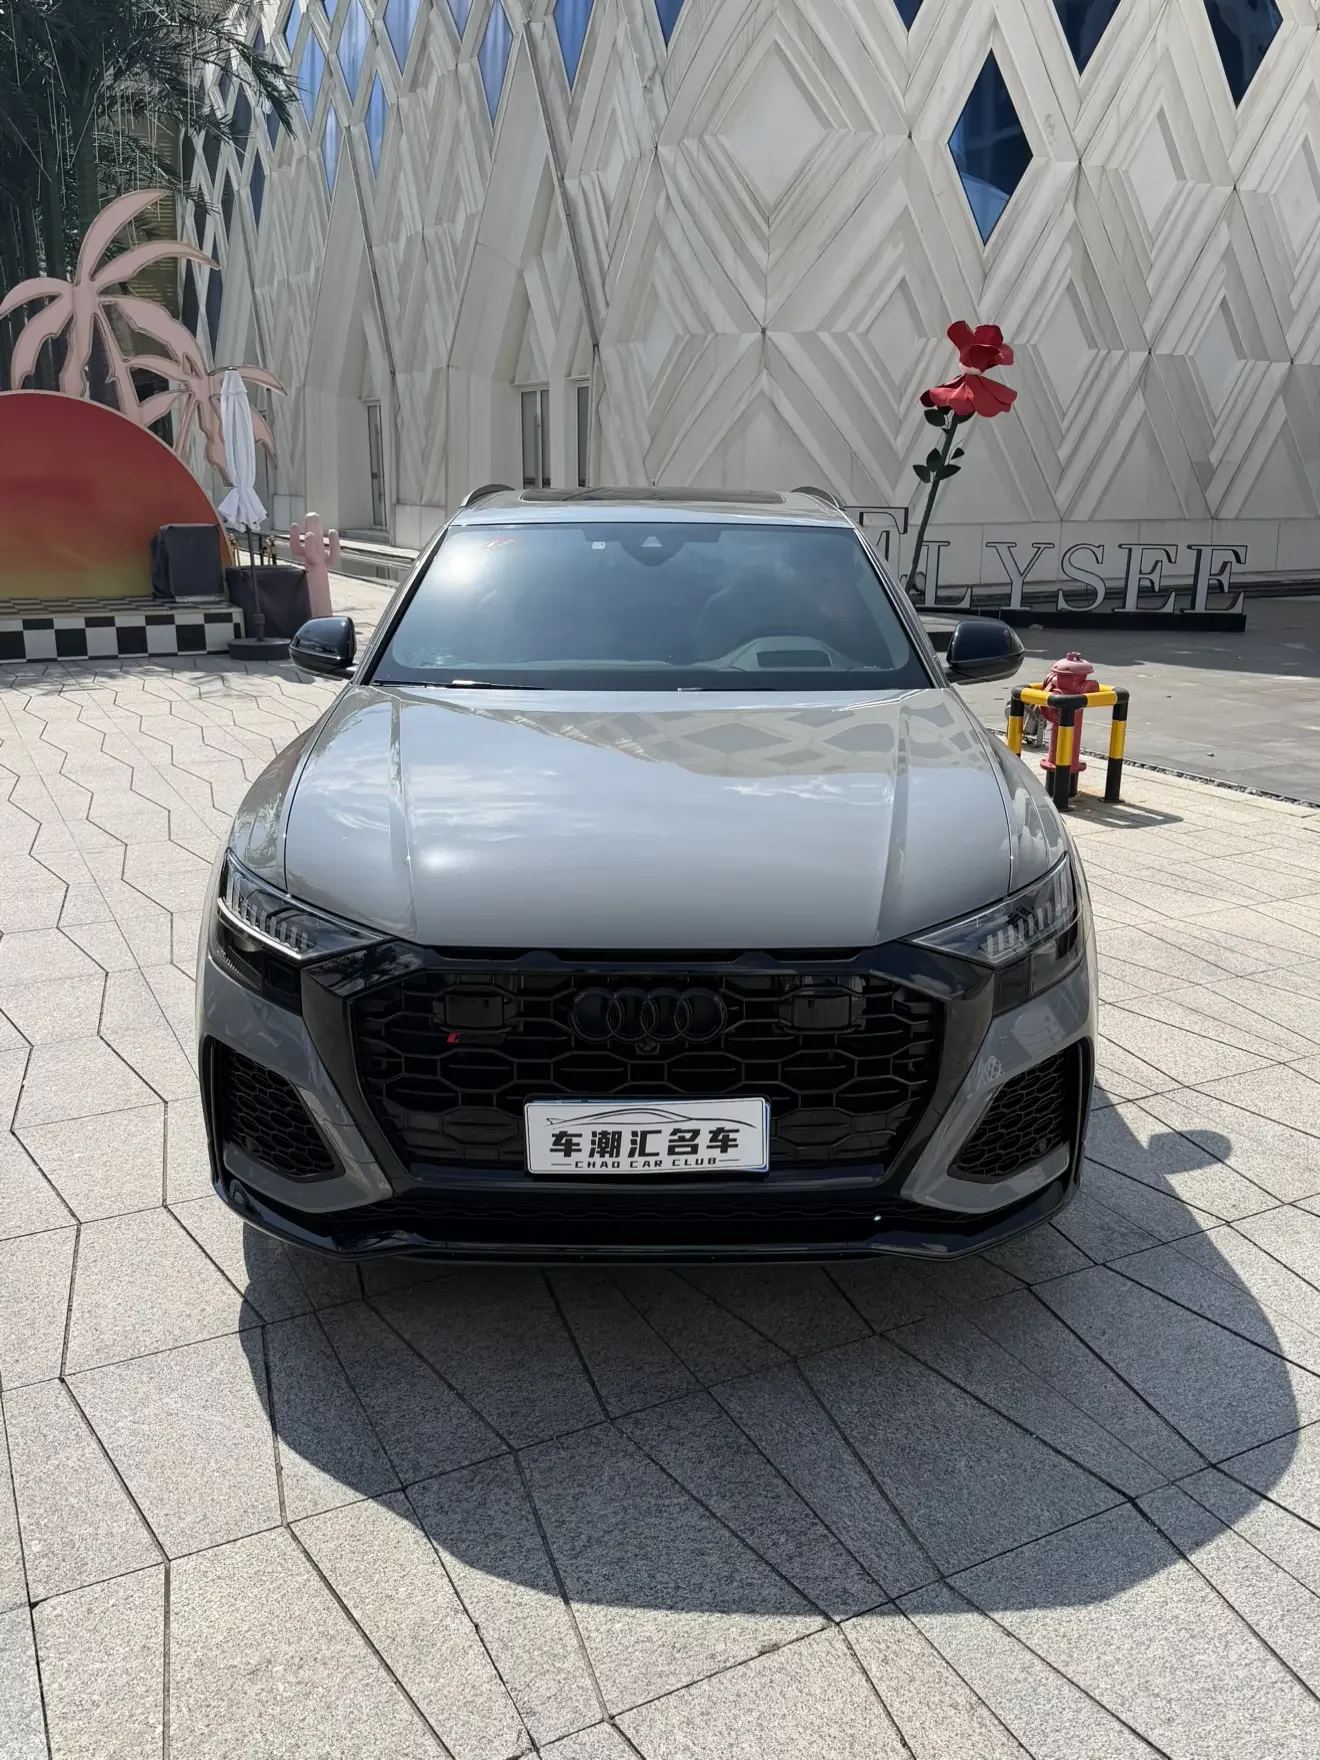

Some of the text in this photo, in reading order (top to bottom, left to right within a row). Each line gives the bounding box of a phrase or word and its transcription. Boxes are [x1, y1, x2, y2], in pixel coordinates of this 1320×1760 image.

[550, 1127, 740, 1158] 车潮汇名车
[574, 1157, 717, 1169] CHAO CAR CLUB
